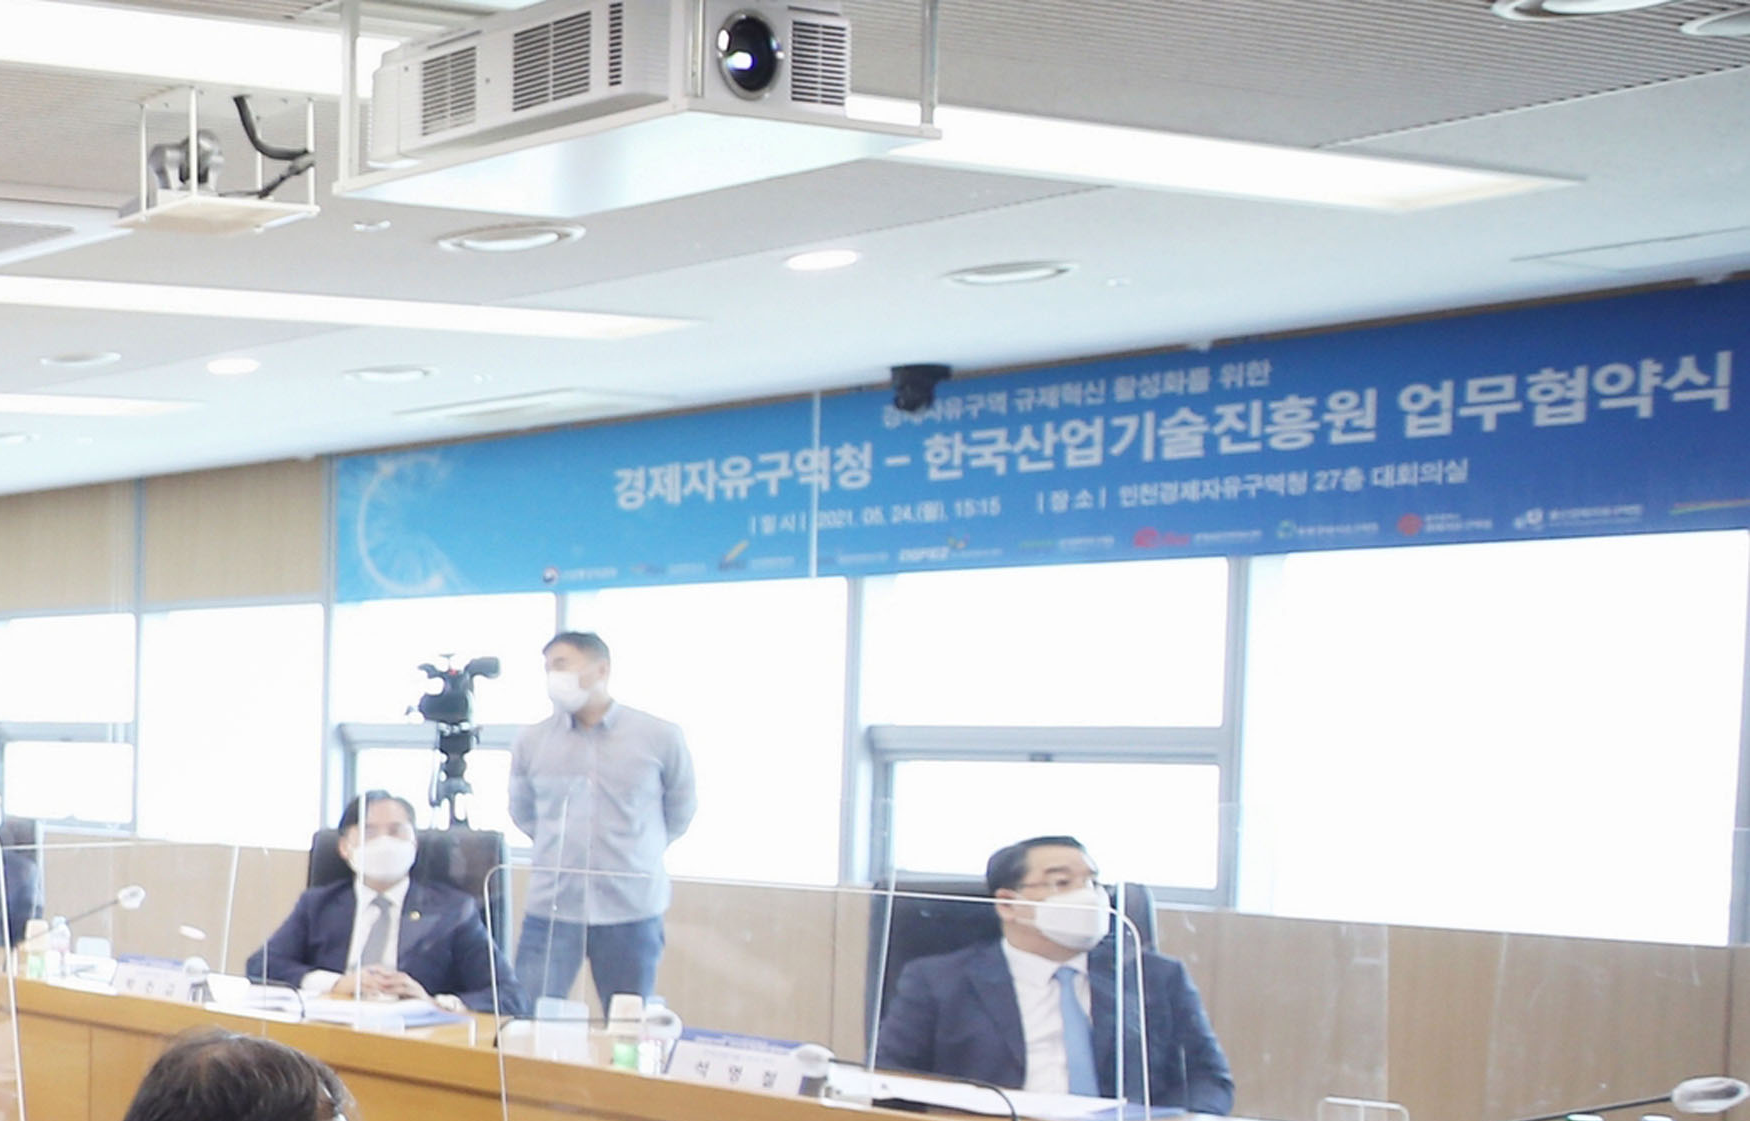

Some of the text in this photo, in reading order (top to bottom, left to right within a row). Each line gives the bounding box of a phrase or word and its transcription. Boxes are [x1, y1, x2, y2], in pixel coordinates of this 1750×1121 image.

[1014, 379, 1106, 412] 규제혁신
[1113, 366, 1211, 403] 활성화를
[1219, 359, 1273, 390] 위한
[614, 442, 873, 510] 경제자유구역청
[923, 387, 1377, 481] 한국산업기술진흥원
[1397, 350, 1732, 438] 업무협약식
[1119, 470, 1308, 508] 인천경제자유구역청
[1314, 465, 1364, 492] 27층
[1370, 457, 1469, 488] 대회의실
